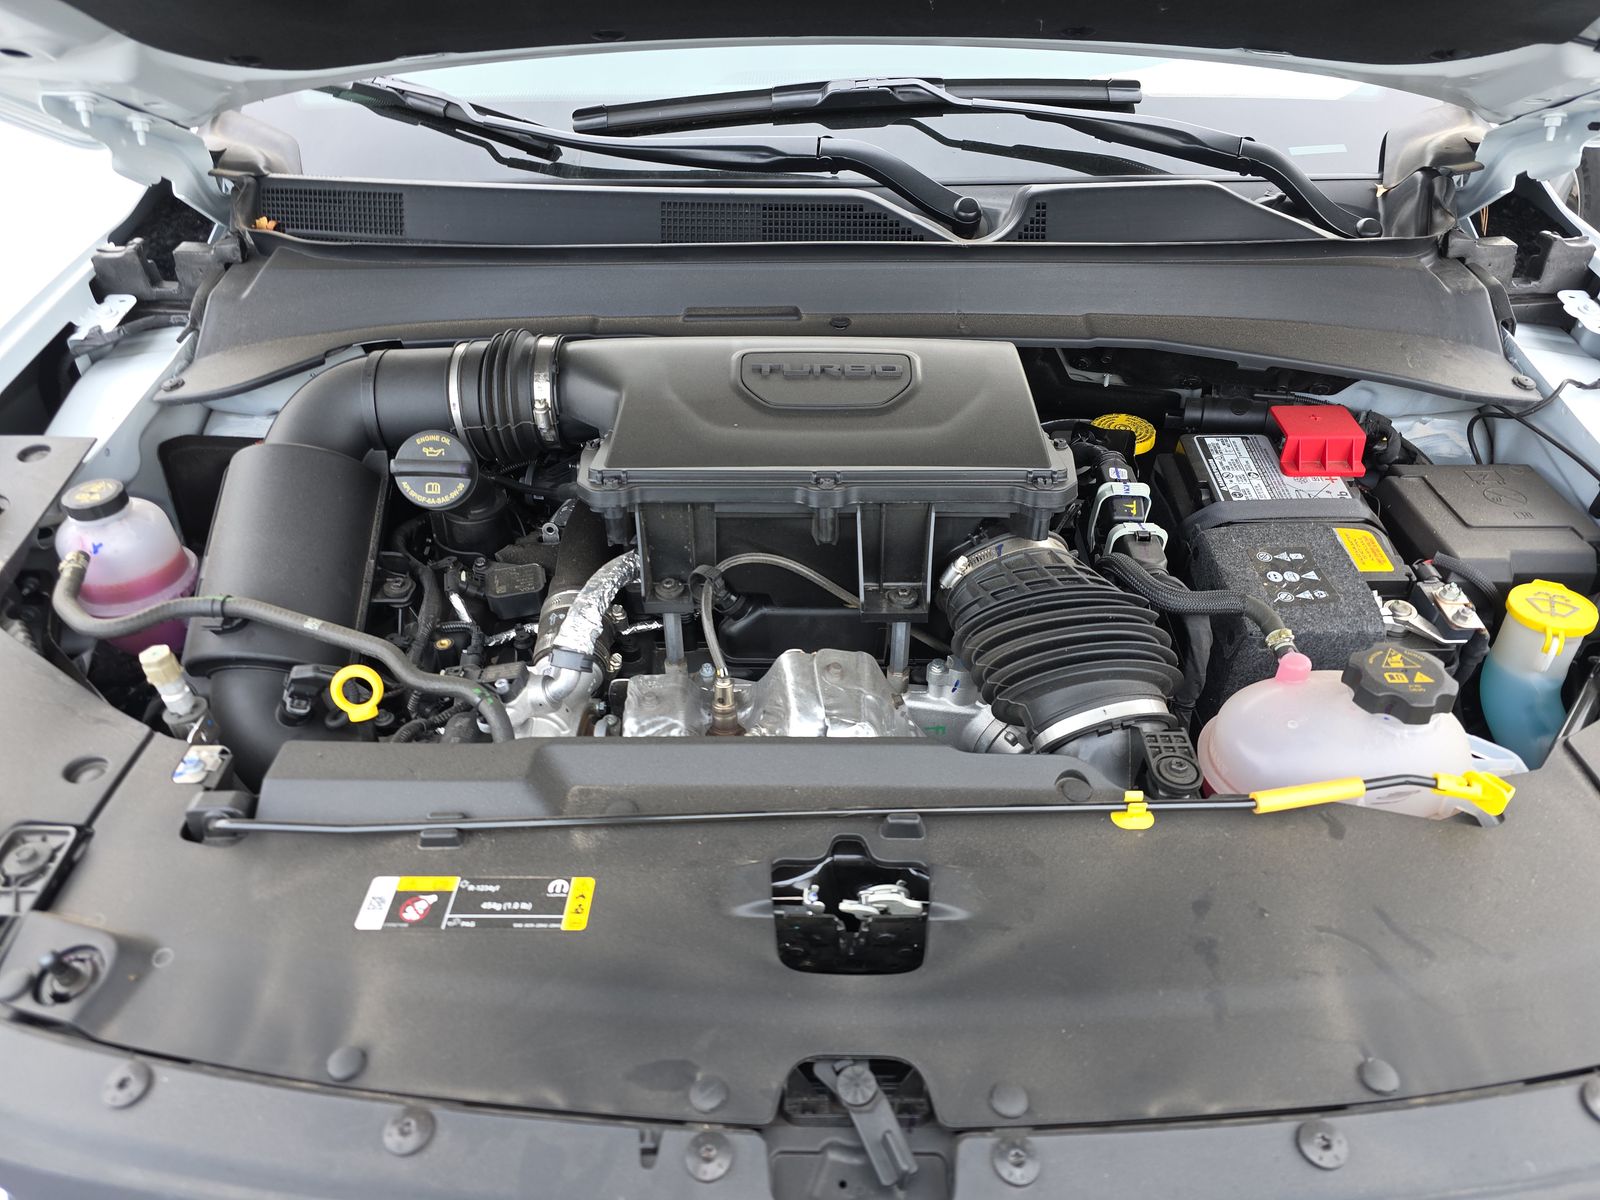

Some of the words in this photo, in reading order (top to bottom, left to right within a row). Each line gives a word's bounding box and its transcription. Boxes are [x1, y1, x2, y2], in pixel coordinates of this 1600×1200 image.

[750, 363, 904, 378] TURBO
[415, 435, 440, 445] ENGINE
[441, 436, 452, 447] OIL
